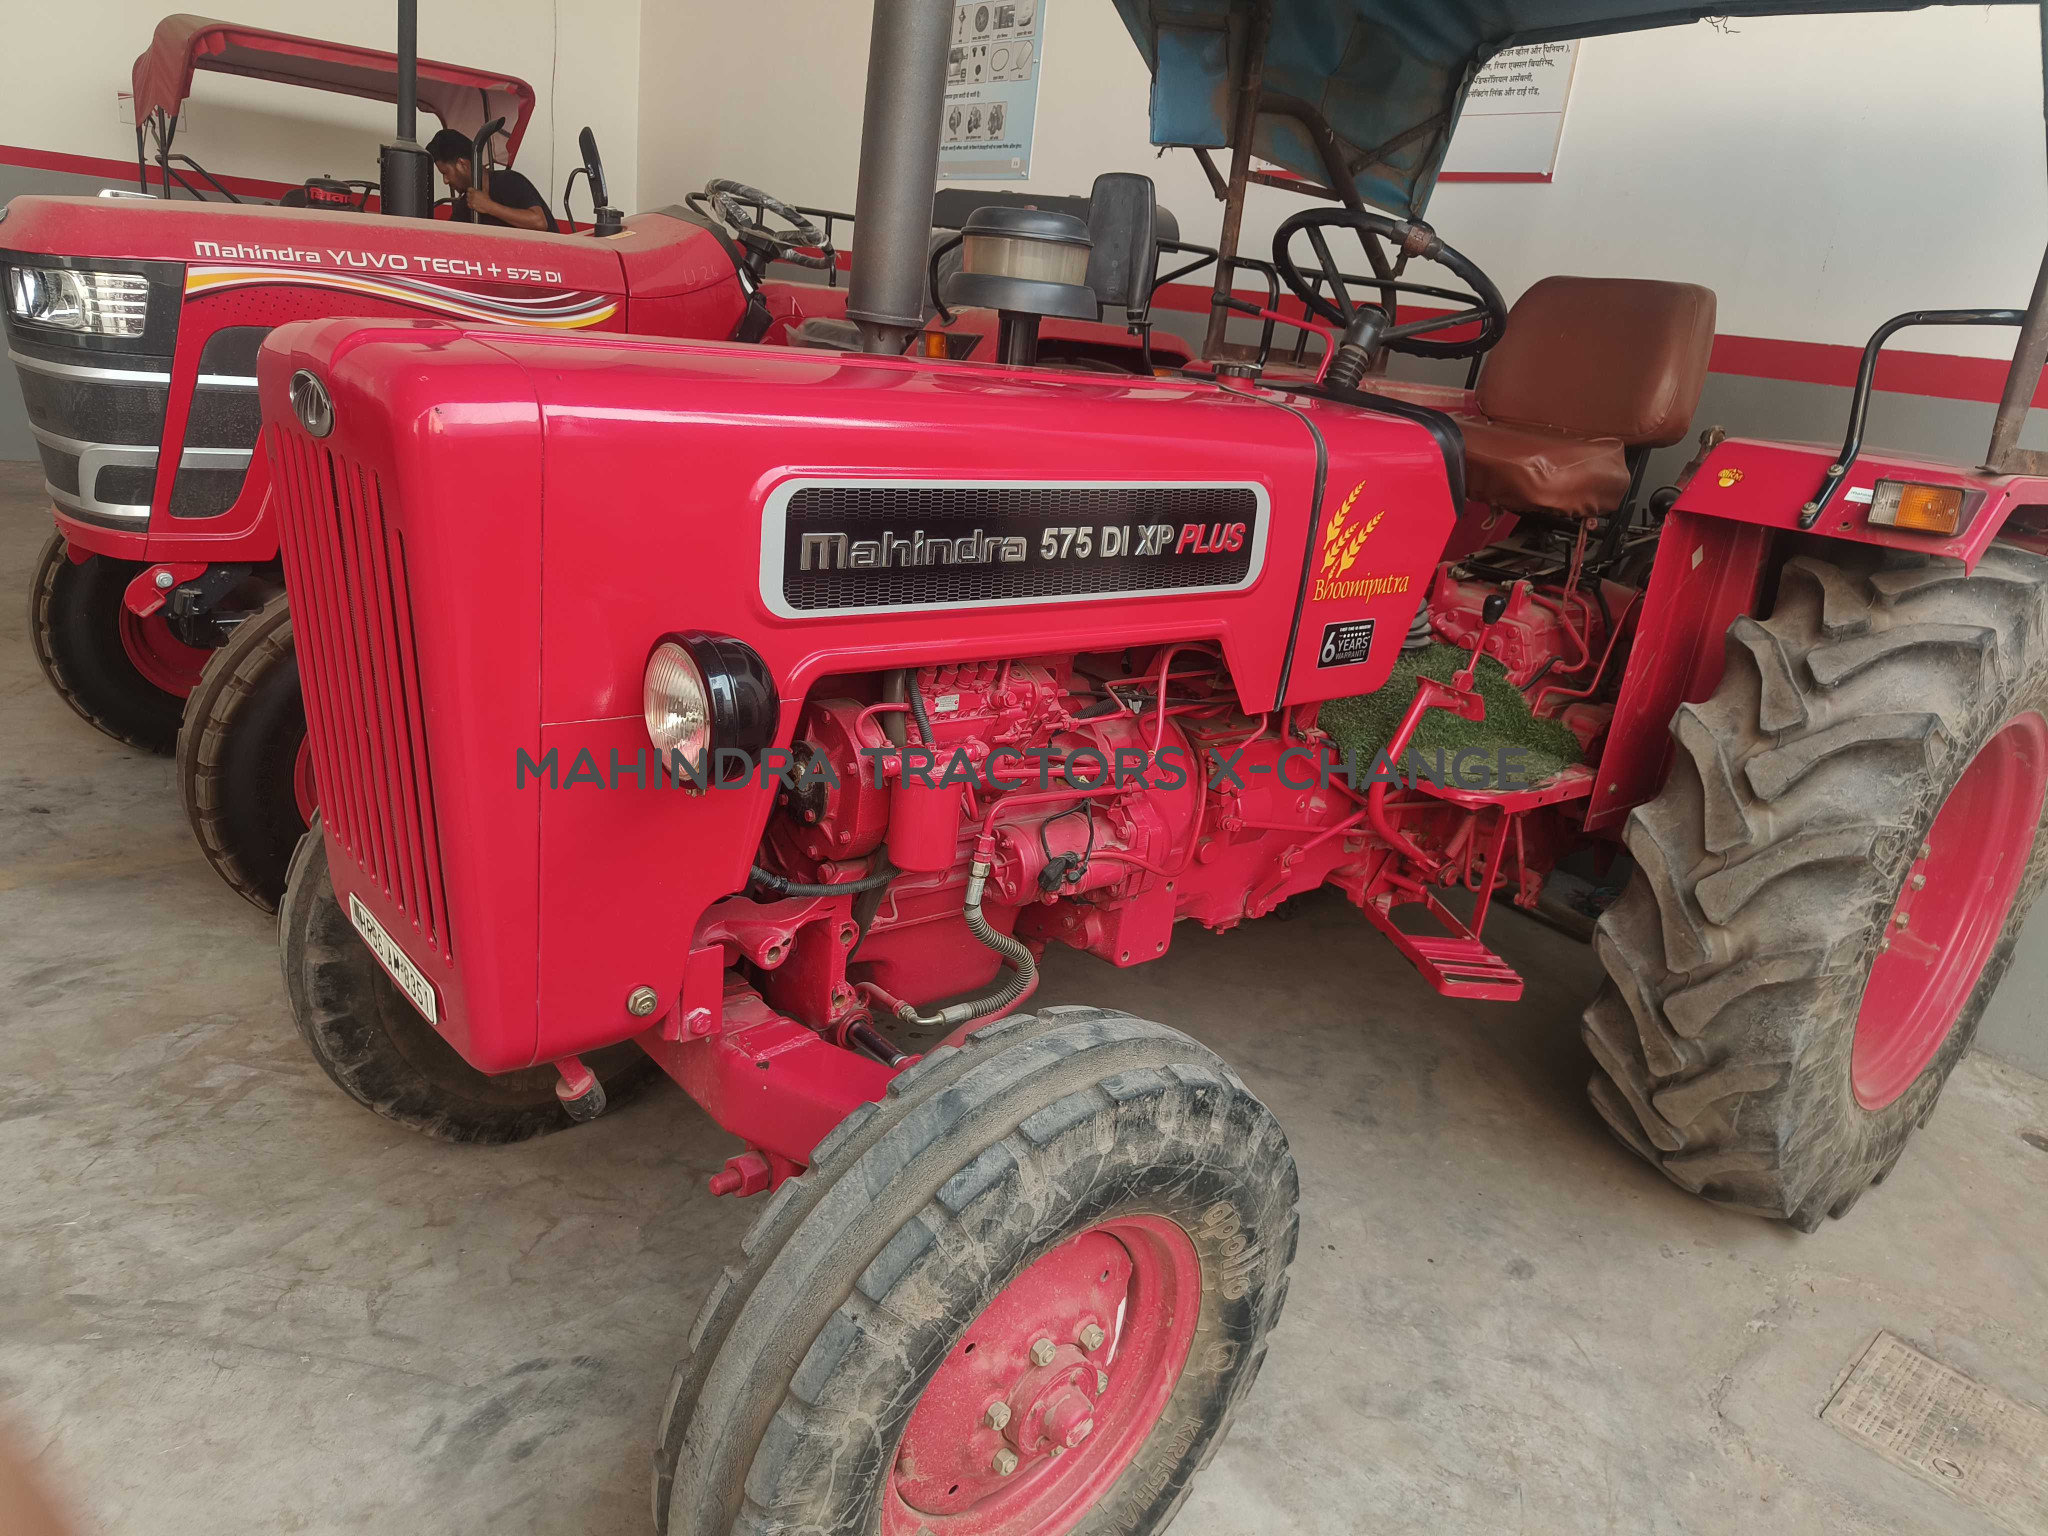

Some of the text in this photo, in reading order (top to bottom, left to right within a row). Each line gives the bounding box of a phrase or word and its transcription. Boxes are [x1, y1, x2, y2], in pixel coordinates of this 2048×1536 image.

[1530, 46, 1542, 55] और
[1504, 88, 1516, 97] और
[194, 241, 321, 264] Mahindra
[327, 249, 408, 271] YUVO
[413, 256, 483, 277] TECH
[507, 267, 542, 282] 575
[545, 272, 562, 284] DI
[800, 522, 1247, 571] Mahindra 575 DI XP PLUS
[1312, 572, 1410, 605] Bhoomiputra
[1321, 631, 1336, 663] 6
[1335, 650, 1366, 660] WARRANTY
[1198, 1200, 1262, 1300] apollo
